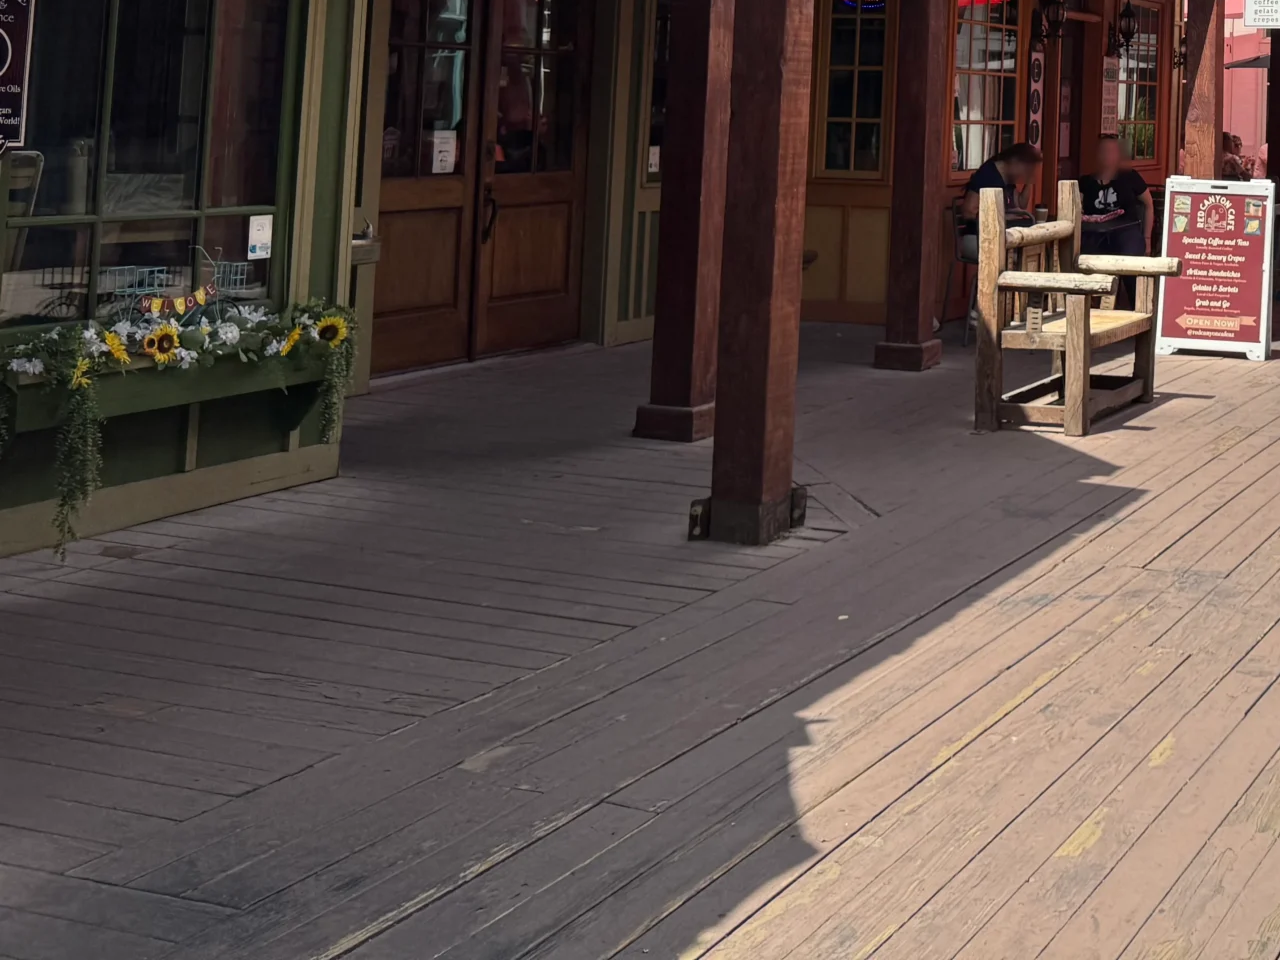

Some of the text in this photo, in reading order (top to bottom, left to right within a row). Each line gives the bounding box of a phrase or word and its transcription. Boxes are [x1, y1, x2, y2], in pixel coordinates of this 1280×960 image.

[6, 84, 21, 93] Oils
[1197, 195, 1236, 231] RED CANYON CAFE
[1182, 236, 1207, 245] Specialty
[1208, 237, 1224, 246] Coffee
[1186, 268, 1241, 278] Artisan Sandwiches
[1195, 298, 1209, 306] Grab
